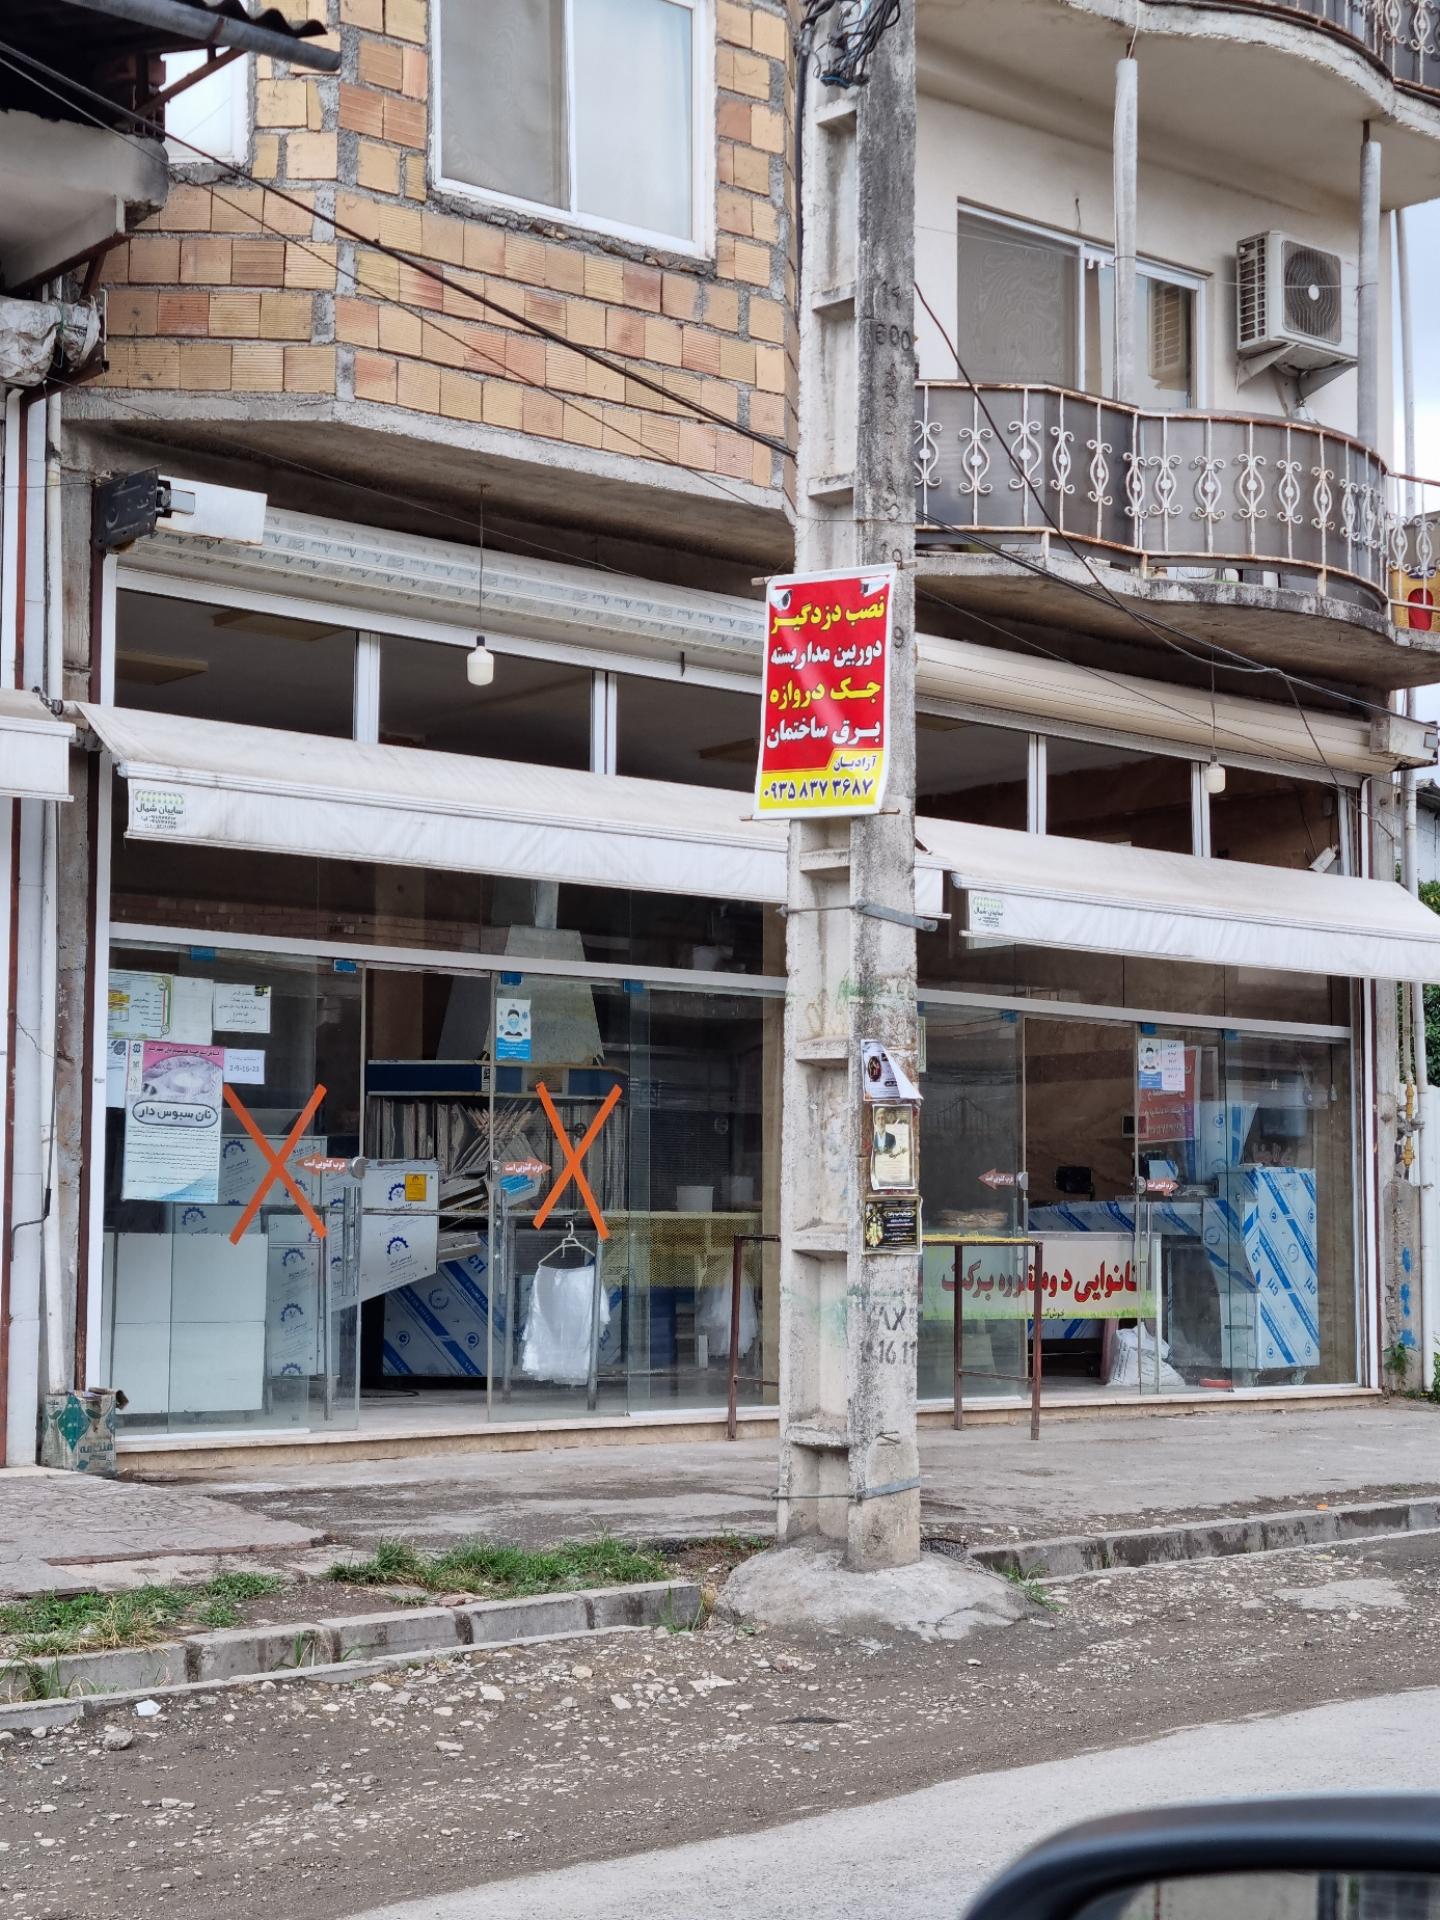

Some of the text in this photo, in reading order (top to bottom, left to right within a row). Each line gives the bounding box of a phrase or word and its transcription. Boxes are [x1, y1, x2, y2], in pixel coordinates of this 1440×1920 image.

[771, 596, 885, 634] نصب دزدگیر
[770, 639, 882, 671] دوربین مداربسته
[769, 676, 881, 710] جک دروازه
[766, 717, 880, 749] برق ساختمان
[136, 802, 157, 812] شمال
[138, 1106, 212, 1122] نان سبوس دار
[941, 1259, 995, 1301] برکت
